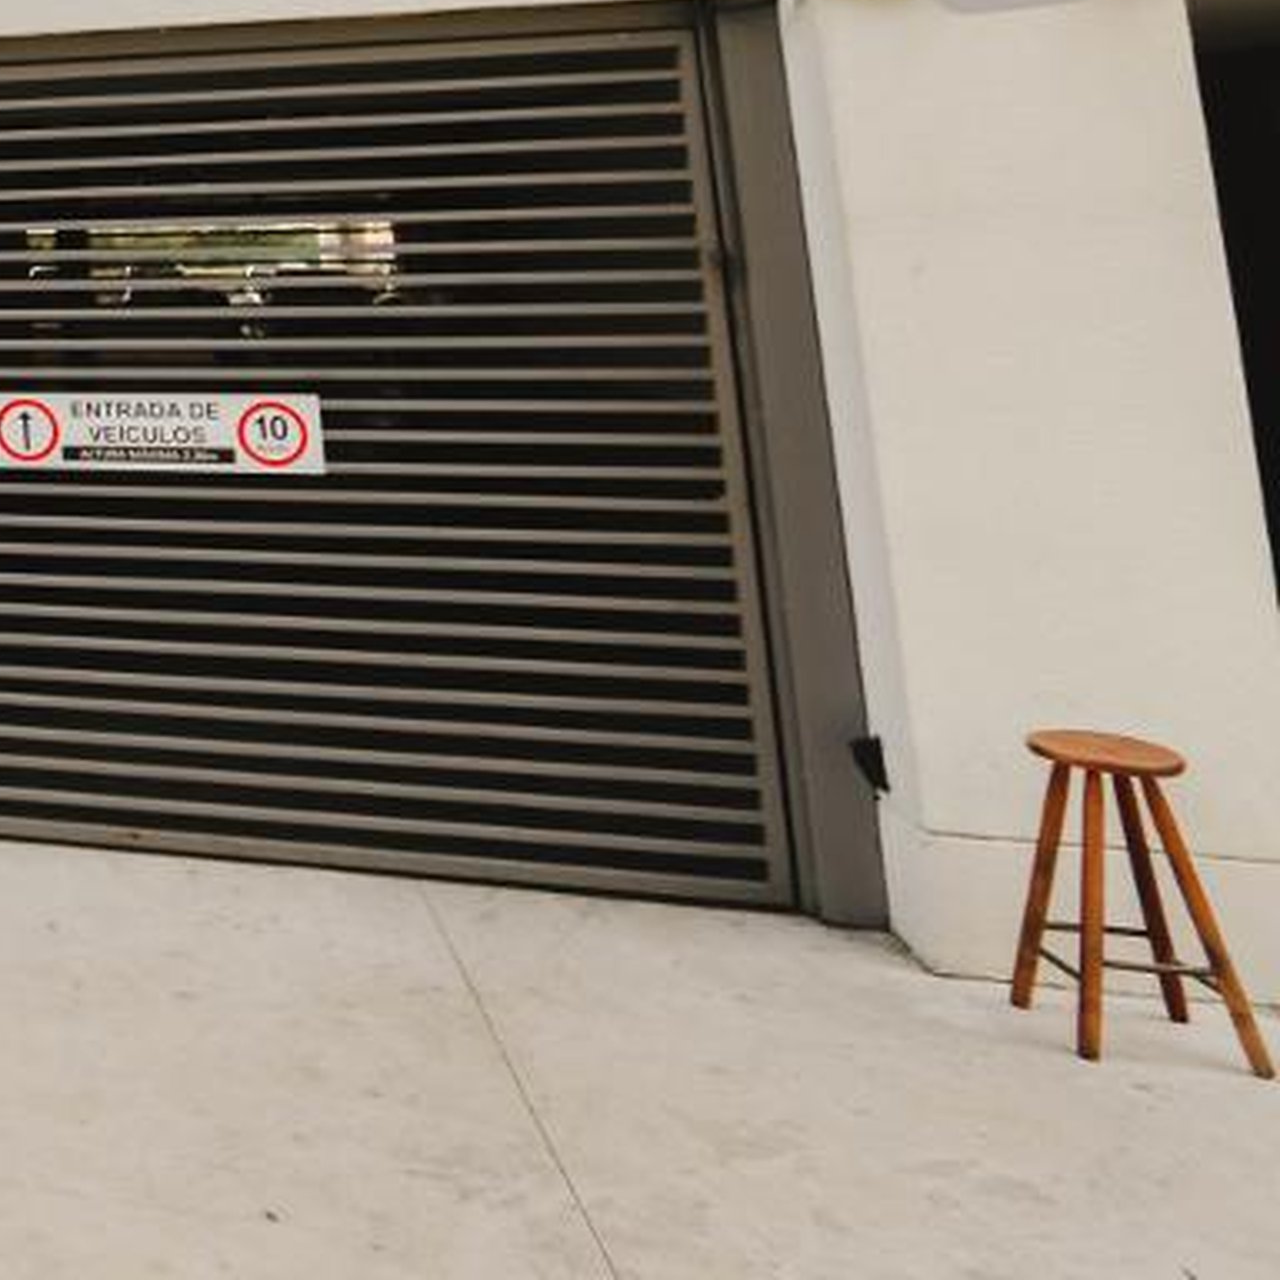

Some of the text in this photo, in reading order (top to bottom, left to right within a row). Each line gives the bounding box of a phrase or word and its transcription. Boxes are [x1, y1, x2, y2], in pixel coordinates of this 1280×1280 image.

[71, 401, 220, 421] ENTRADA DE
[254, 414, 288, 441] 10
